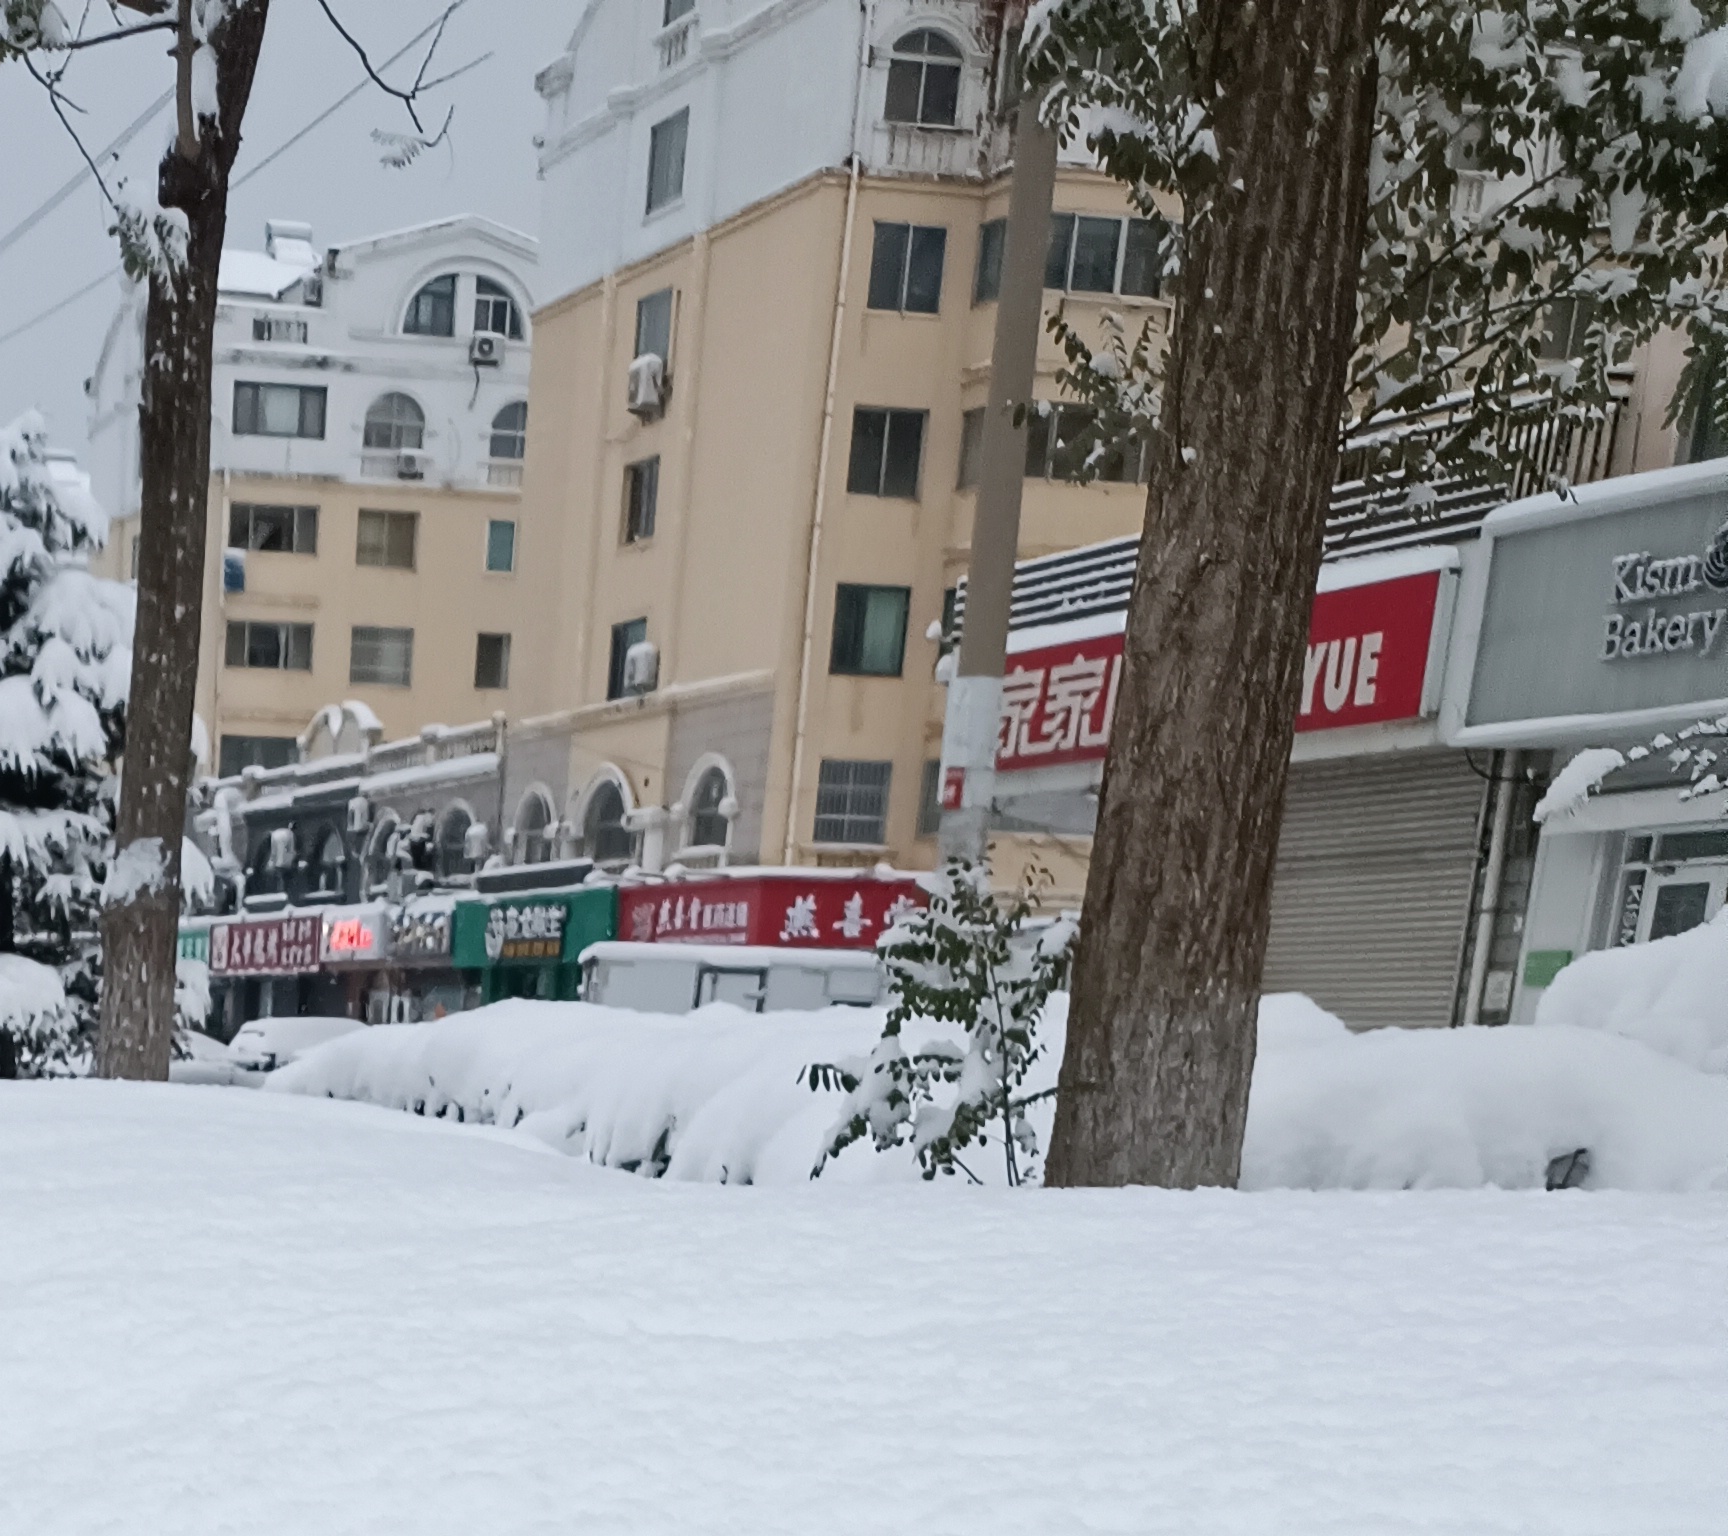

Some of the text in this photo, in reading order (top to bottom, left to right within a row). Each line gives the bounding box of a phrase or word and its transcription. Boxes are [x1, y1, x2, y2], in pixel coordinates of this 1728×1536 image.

[1300, 631, 1384, 716] YUE
[1601, 608, 1726, 660] Bakery
[997, 652, 1122, 758] 家家
